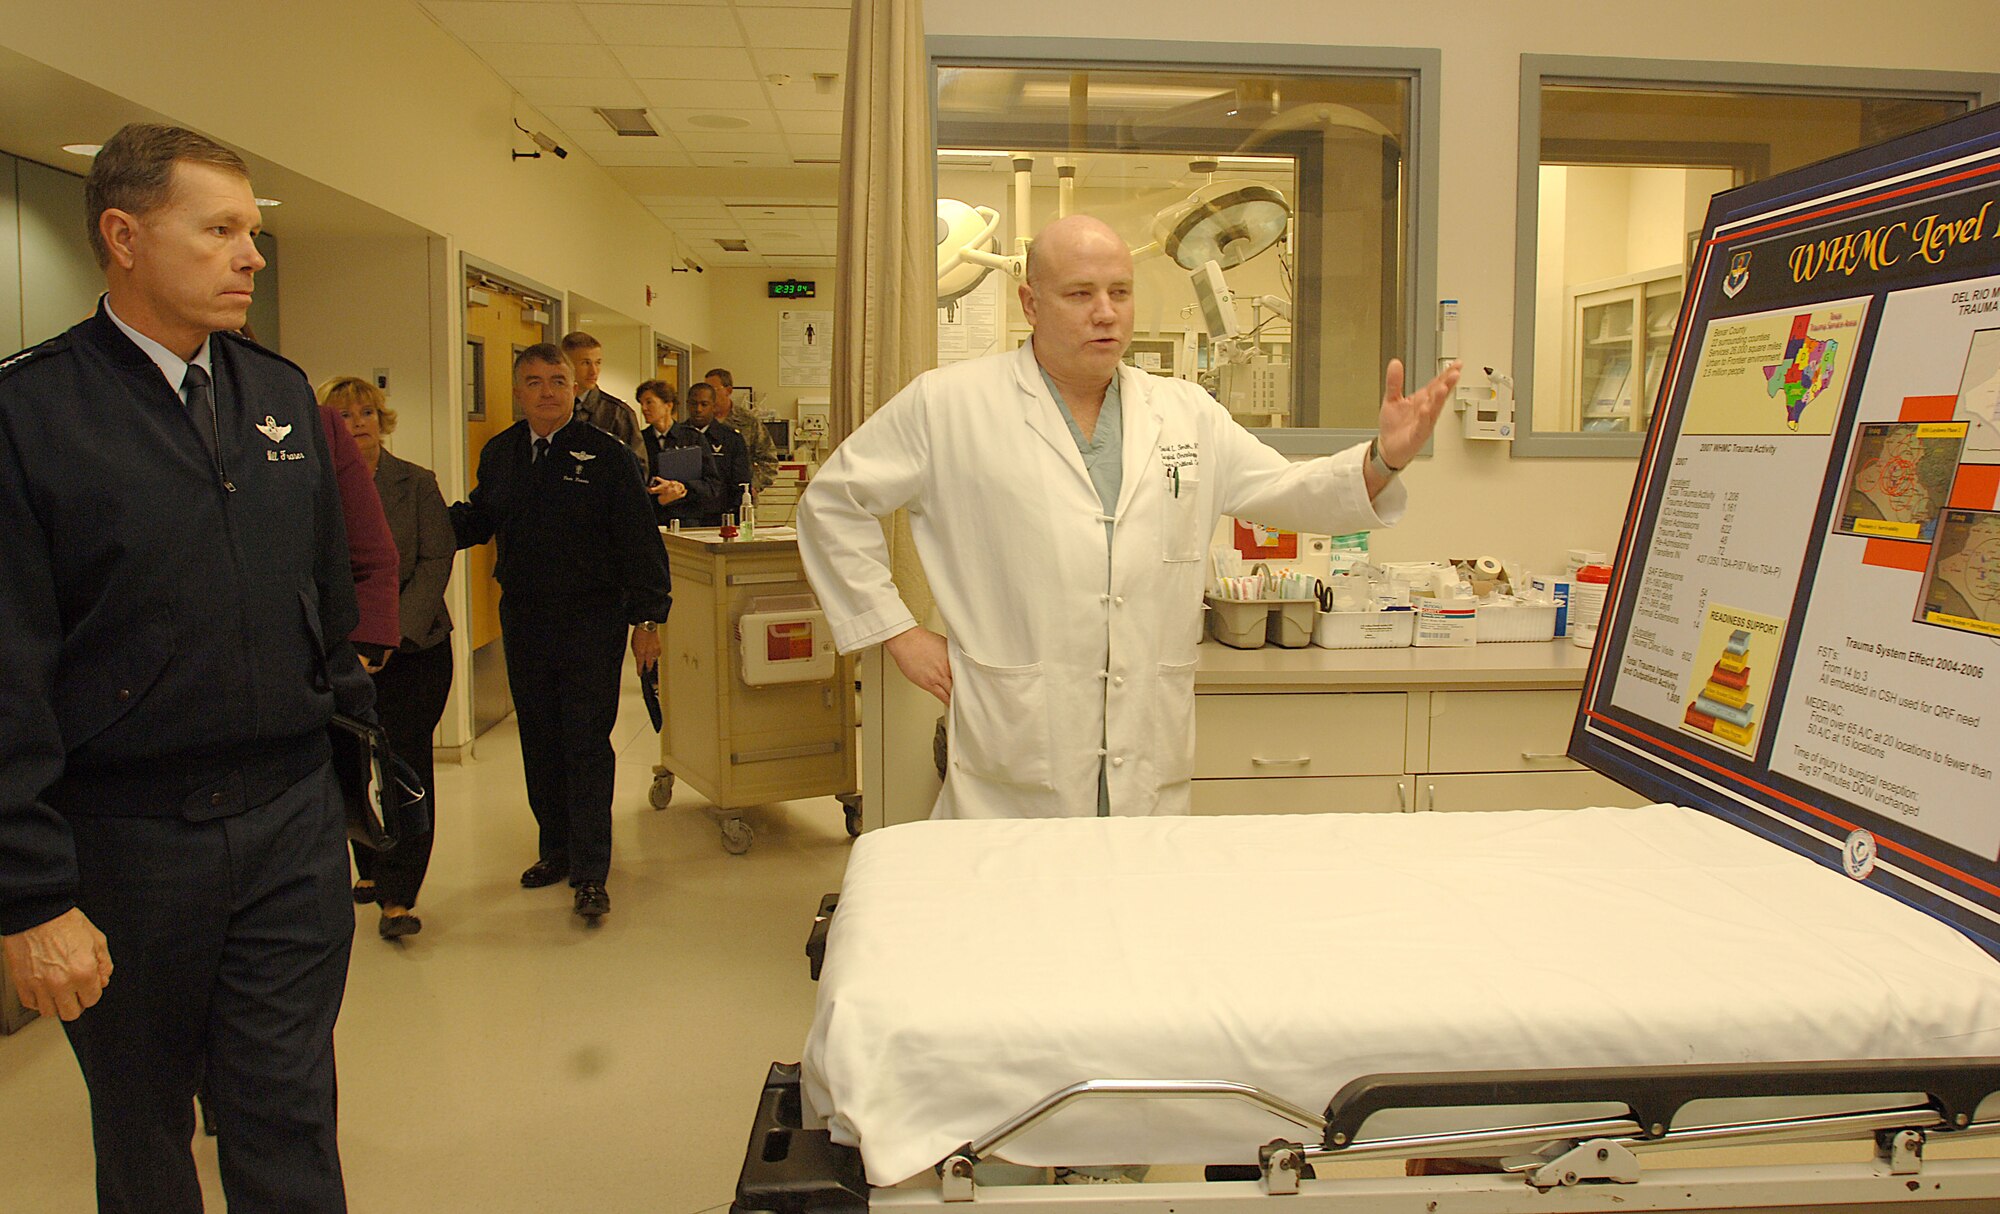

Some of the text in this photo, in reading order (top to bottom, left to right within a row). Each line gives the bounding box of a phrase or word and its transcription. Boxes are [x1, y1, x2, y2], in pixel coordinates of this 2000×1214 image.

[1788, 222, 1907, 284] WHMC
[1907, 200, 1994, 264] Level
[1952, 290, 1970, 304] DEL
[1972, 288, 1990, 301] RIO
[1958, 300, 1999, 316] TRAUMA
[1729, 325, 1747, 335] County
[1719, 336, 1748, 346] surrounding
[1748, 333, 1771, 343] counties
[1708, 347, 1728, 357] Services
[1748, 344, 1766, 355] square
[1767, 341, 1783, 351] miles
[1728, 355, 1747, 365] Frontier
[1748, 352, 1781, 364] environment
[1711, 367, 1727, 377] million
[1728, 366, 1745, 377] people
[1713, 443, 1731, 452] WHMC
[1734, 444, 1753, 453] Trauma
[1754, 444, 1776, 456] Activity
[1666, 497, 1683, 507] Trauma
[1683, 499, 1711, 509] Admissions
[1672, 508, 1699, 519] Admissions
[1673, 519, 1700, 530] Admissions
[1659, 526, 1676, 537] Trauma
[1675, 529, 1693, 540] Deaths
[1747, 560, 1759, 572] Non
[1653, 609, 1680, 624] Extensions
[1710, 610, 1779, 635] READINESS SUPPORT
[1846, 636, 1984, 679] Trauma System Effect 2004-2006
[1638, 659, 1656, 673] Trauma
[1656, 664, 1680, 680] Inpatient
[1822, 660, 1868, 682] From 14 to 3
[1623, 666, 1678, 693] and Outpatient Activity
[1805, 695, 1845, 717] MEDEVAC:
[1819, 672, 1981, 728] All embedded in CSH used for QRF need
[1807, 723, 1817, 735] 50
[1832, 731, 1841, 743] at
[1841, 734, 1851, 747] 15
[1851, 737, 1885, 760] locations
[1810, 710, 1992, 781] From over 65 A/C at 20 locations to fewer than
[1793, 744, 1919, 801] Time of injury to surgical reception:
[1798, 762, 1920, 818] avg 97 minutes DOW unchanged
